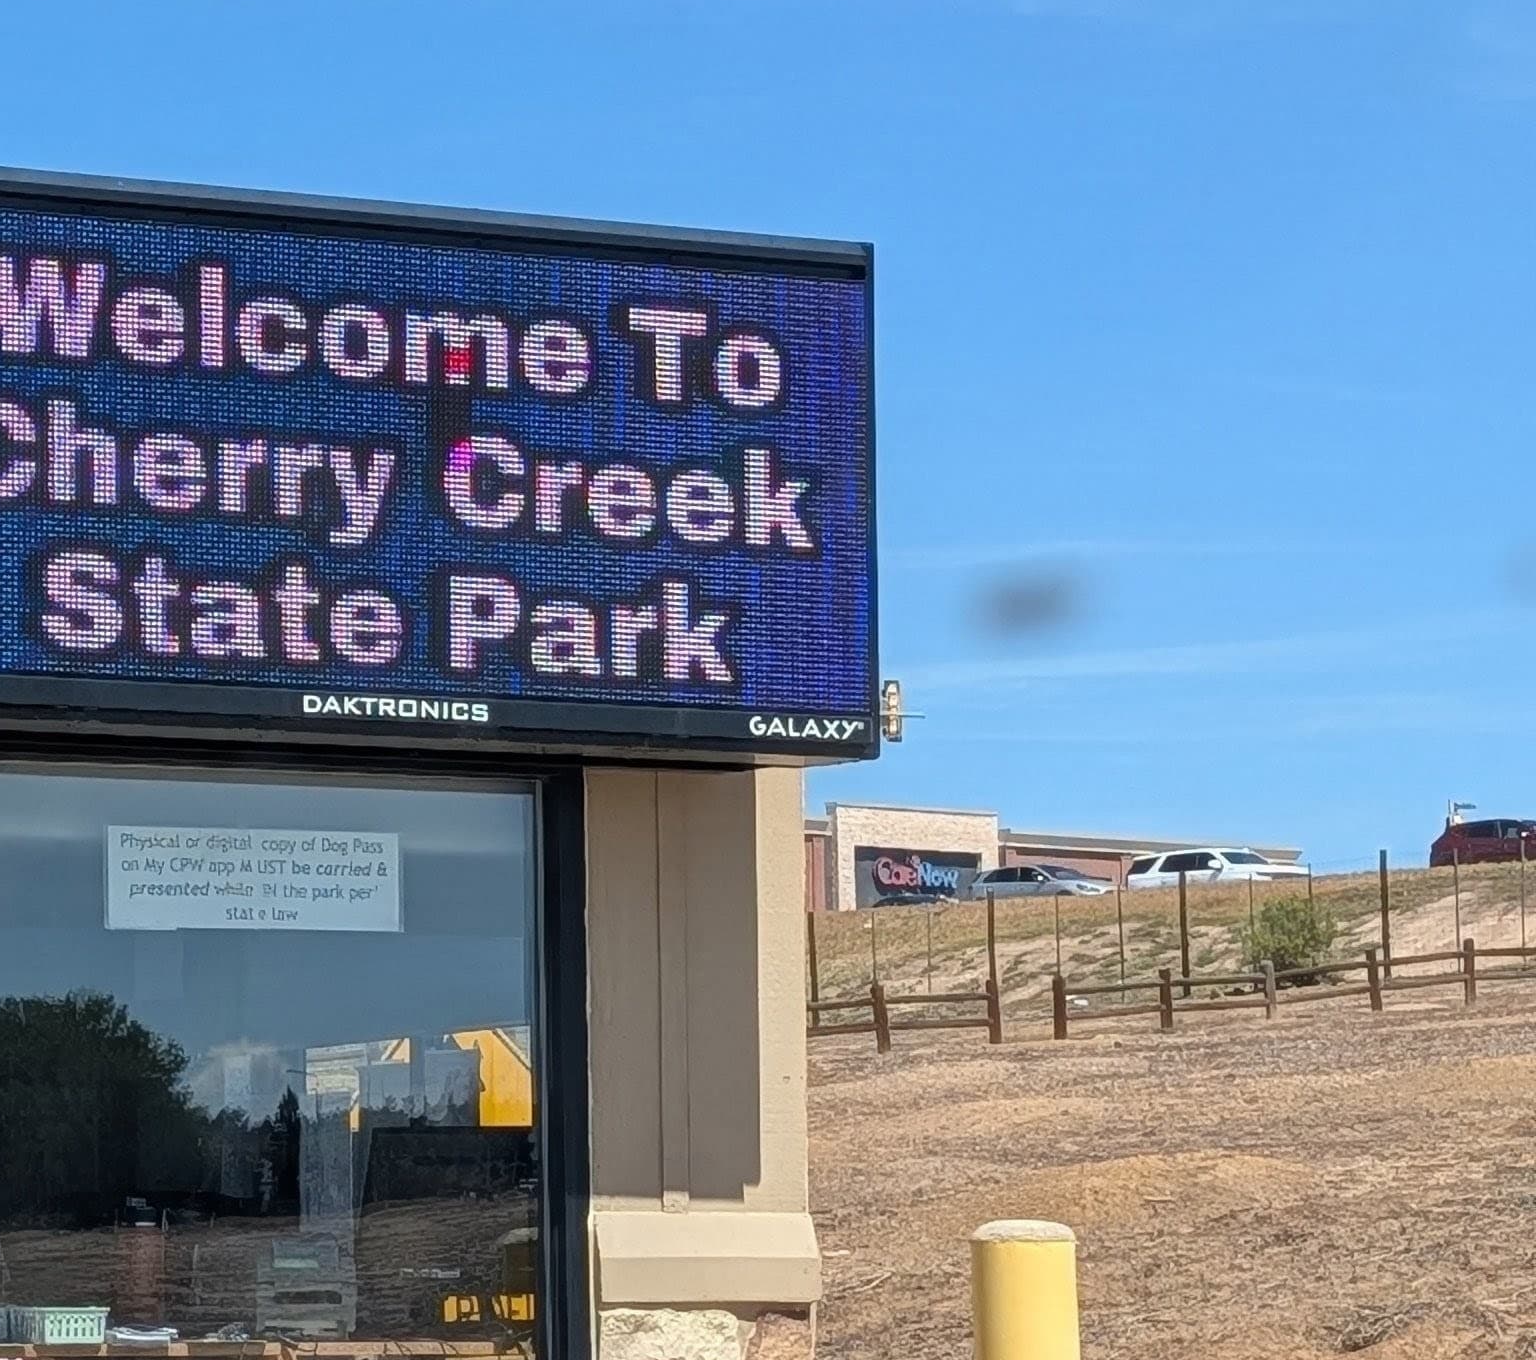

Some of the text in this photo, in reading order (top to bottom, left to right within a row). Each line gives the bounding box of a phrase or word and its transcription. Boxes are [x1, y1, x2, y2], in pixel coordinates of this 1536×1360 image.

[627, 307, 783, 408] To
[441, 433, 815, 548] Creek
[40, 551, 734, 683] State Park
[303, 695, 488, 722] DAKTRONICS
[750, 716, 858, 739] GALAXY
[120, 832, 180, 851] Physical
[206, 834, 252, 853] digital
[261, 839, 296, 854] copy
[301, 836, 317, 852] of
[321, 837, 349, 856] Dog
[121, 860, 139, 871] on
[144, 858, 165, 875] My
[208, 861, 235, 876] app
[292, 860, 311, 875] be
[316, 861, 372, 876] carried
[376, 862, 388, 876] &
[129, 881, 210, 899] presented
[284, 883, 307, 898] the
[312, 884, 344, 901] park
